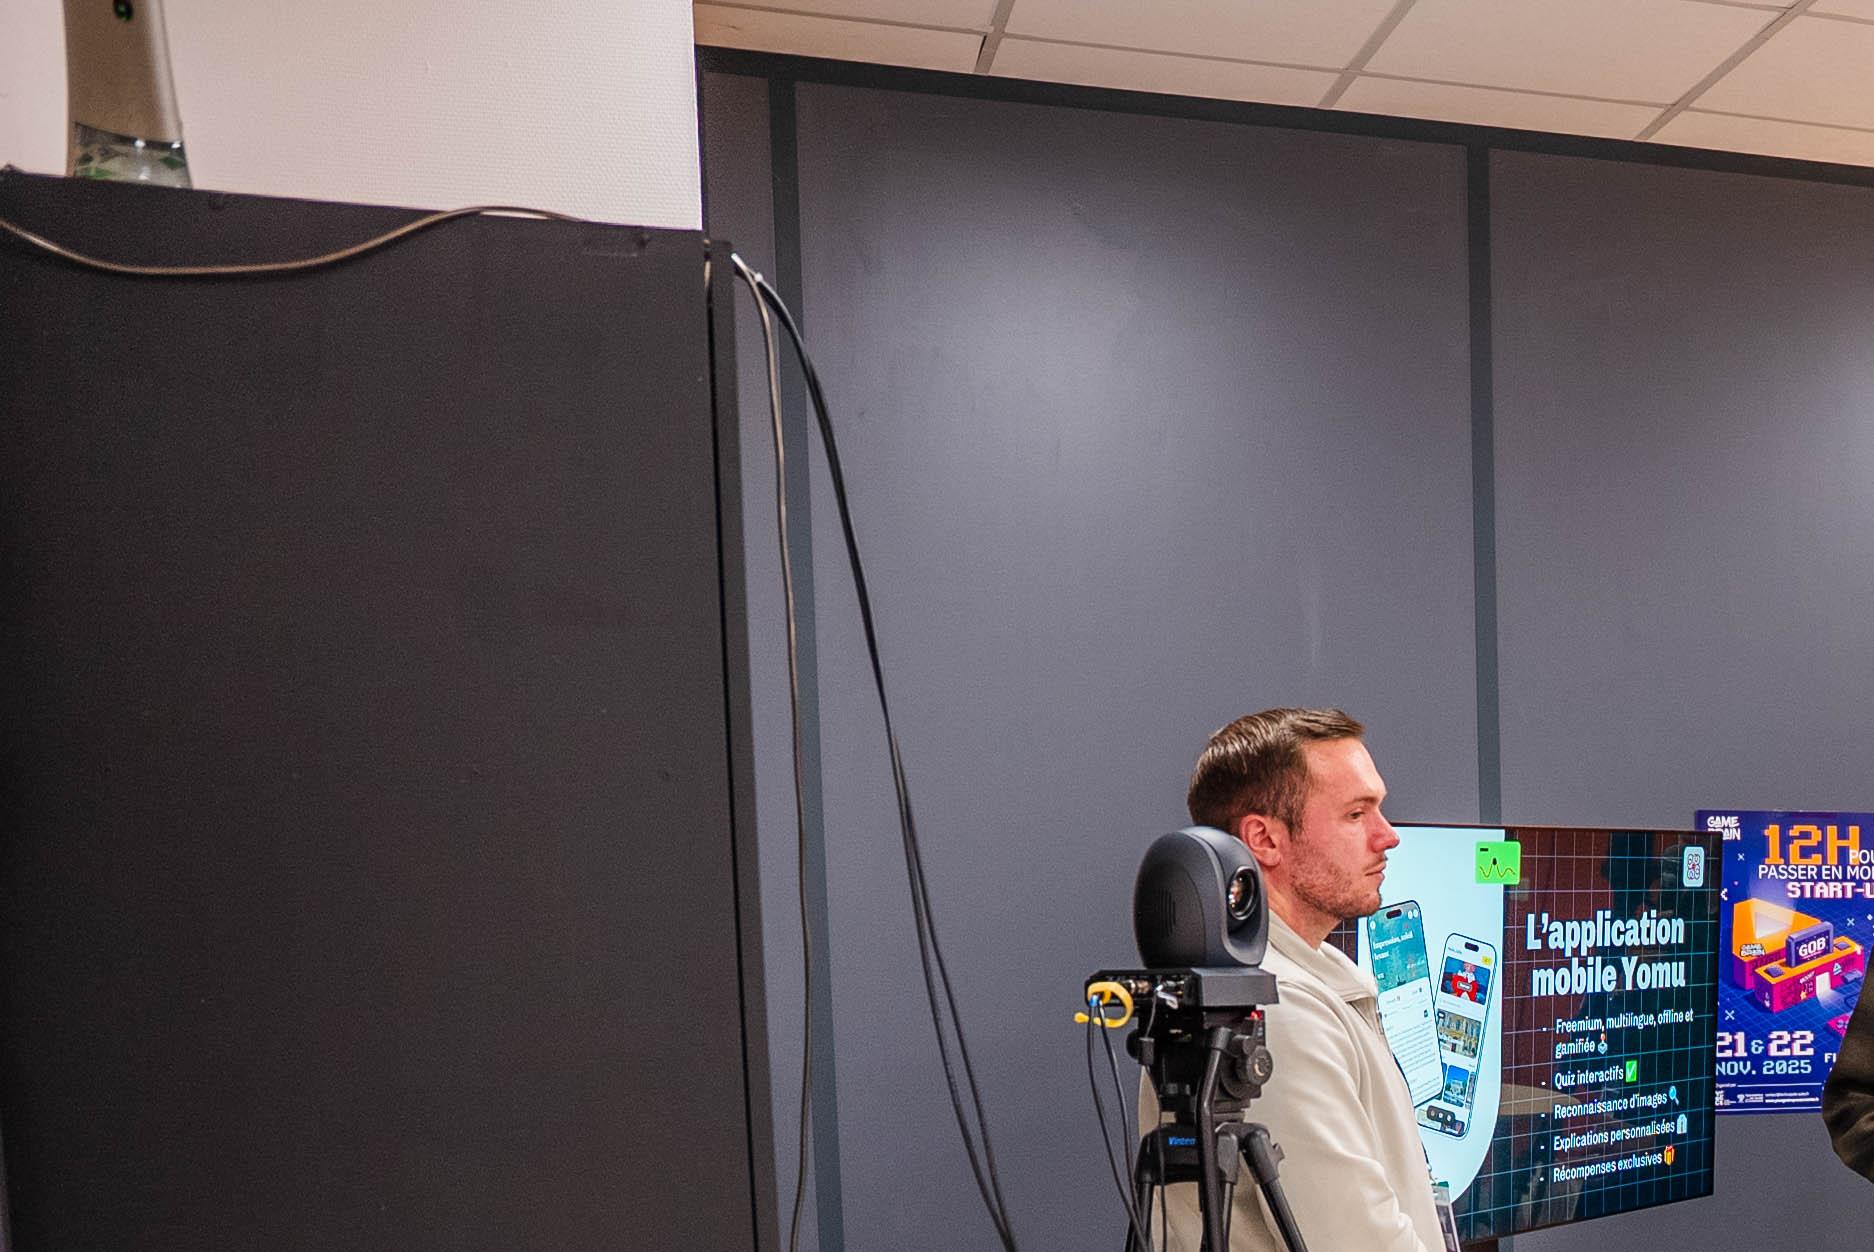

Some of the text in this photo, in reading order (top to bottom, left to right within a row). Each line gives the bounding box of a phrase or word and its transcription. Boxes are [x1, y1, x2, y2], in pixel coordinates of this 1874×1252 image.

[1706, 816, 1741, 828] GAME
[1708, 828, 1742, 841] AIN
[1763, 824, 1861, 866] 12H
[1758, 865, 1817, 880] PASSER
[1821, 865, 1842, 880] EN
[1526, 909, 1685, 957] L'application
[1798, 936, 1827, 957] GOB
[1532, 955, 1686, 997] mobile Yomu
[1556, 1008, 1694, 1034] Freemium, multilingue, offline et
[1554, 1036, 1596, 1059] gamifiée
[1715, 1030, 1815, 1057] 21 & 22
[1554, 1065, 1624, 1090] Quiz interactifs
[1715, 1060, 1812, 1076] NOV. 2025
[1554, 1092, 1668, 1120] Reconnaissance d'images
[1553, 1118, 1676, 1153] Explications personnalisées
[1553, 1152, 1663, 1183] Récompenses exclusives
